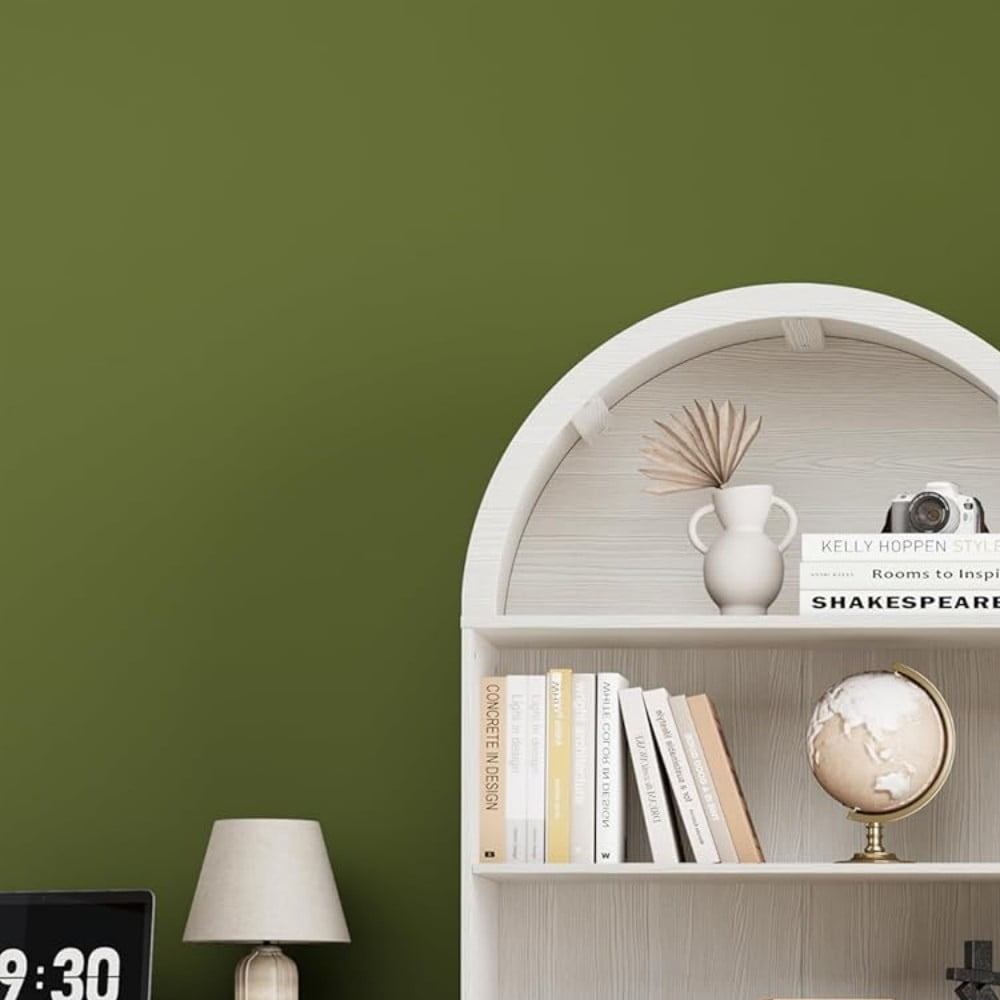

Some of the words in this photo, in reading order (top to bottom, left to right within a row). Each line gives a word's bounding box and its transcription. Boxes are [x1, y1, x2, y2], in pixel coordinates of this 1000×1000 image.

[821, 540, 873, 552] KELLY
[879, 540, 947, 552] HOPPEN
[872, 569, 930, 580] Rooms
[936, 569, 953, 580] to
[485, 683, 500, 748] CONCRETE
[486, 751, 499, 763] IN
[485, 766, 500, 811] DESIGN
